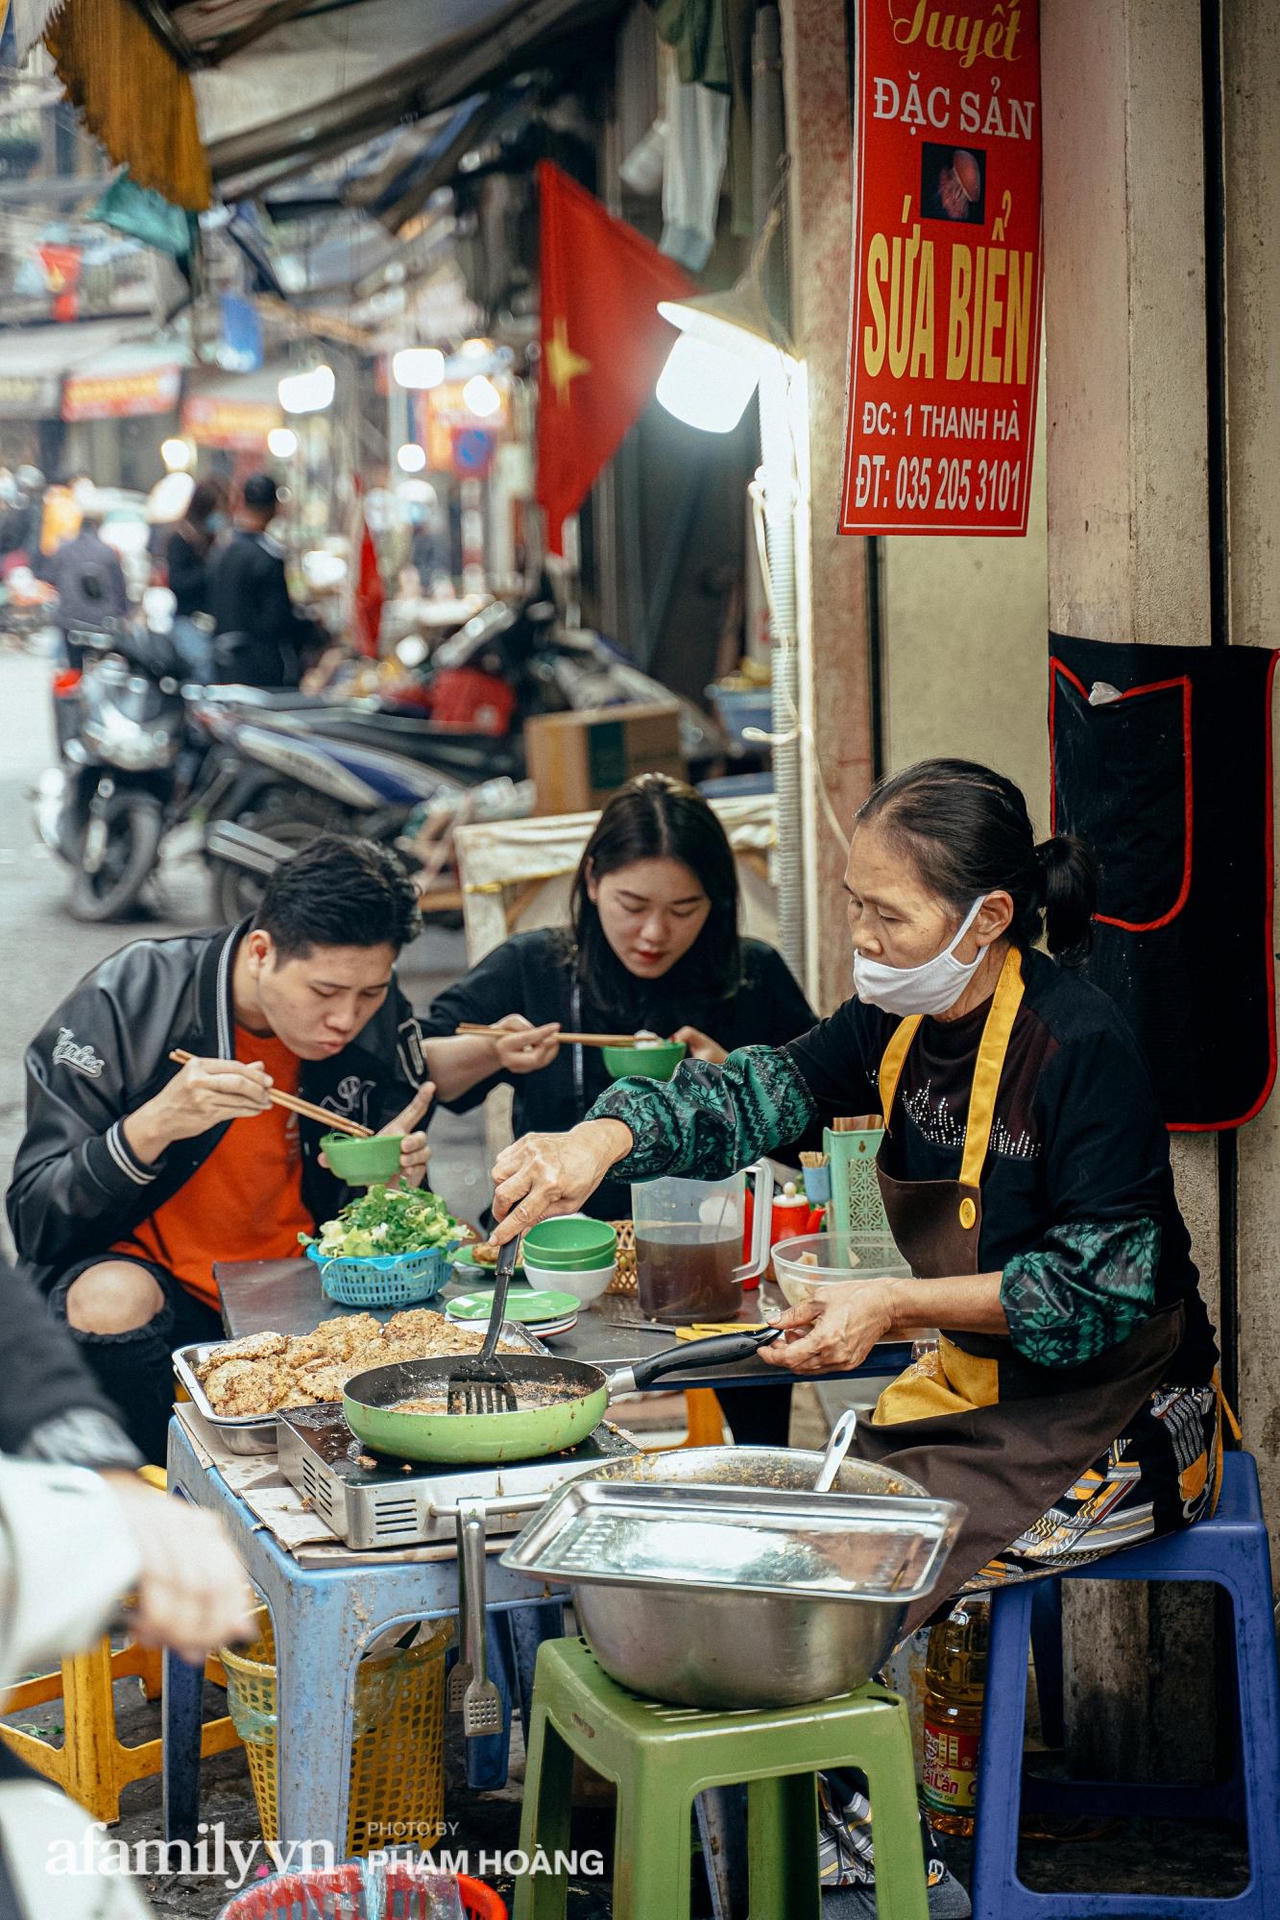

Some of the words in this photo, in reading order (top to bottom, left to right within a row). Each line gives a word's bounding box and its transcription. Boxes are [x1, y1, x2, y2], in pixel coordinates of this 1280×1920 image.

[873, 70, 951, 136] ĐẶC
[959, 76, 1036, 140] SẢN
[863, 194, 935, 379] SỨA
[946, 189, 1034, 385] BIỂN
[862, 401, 898, 436] ĐC:
[904, 403, 914, 437] 1
[920, 404, 988, 440] THANH
[992, 399, 1021, 442] HÀ
[855, 454, 891, 508] ĐT:
[896, 456, 933, 510] 035
[935, 457, 972, 511] 205
[976, 459, 1021, 512] 3101
